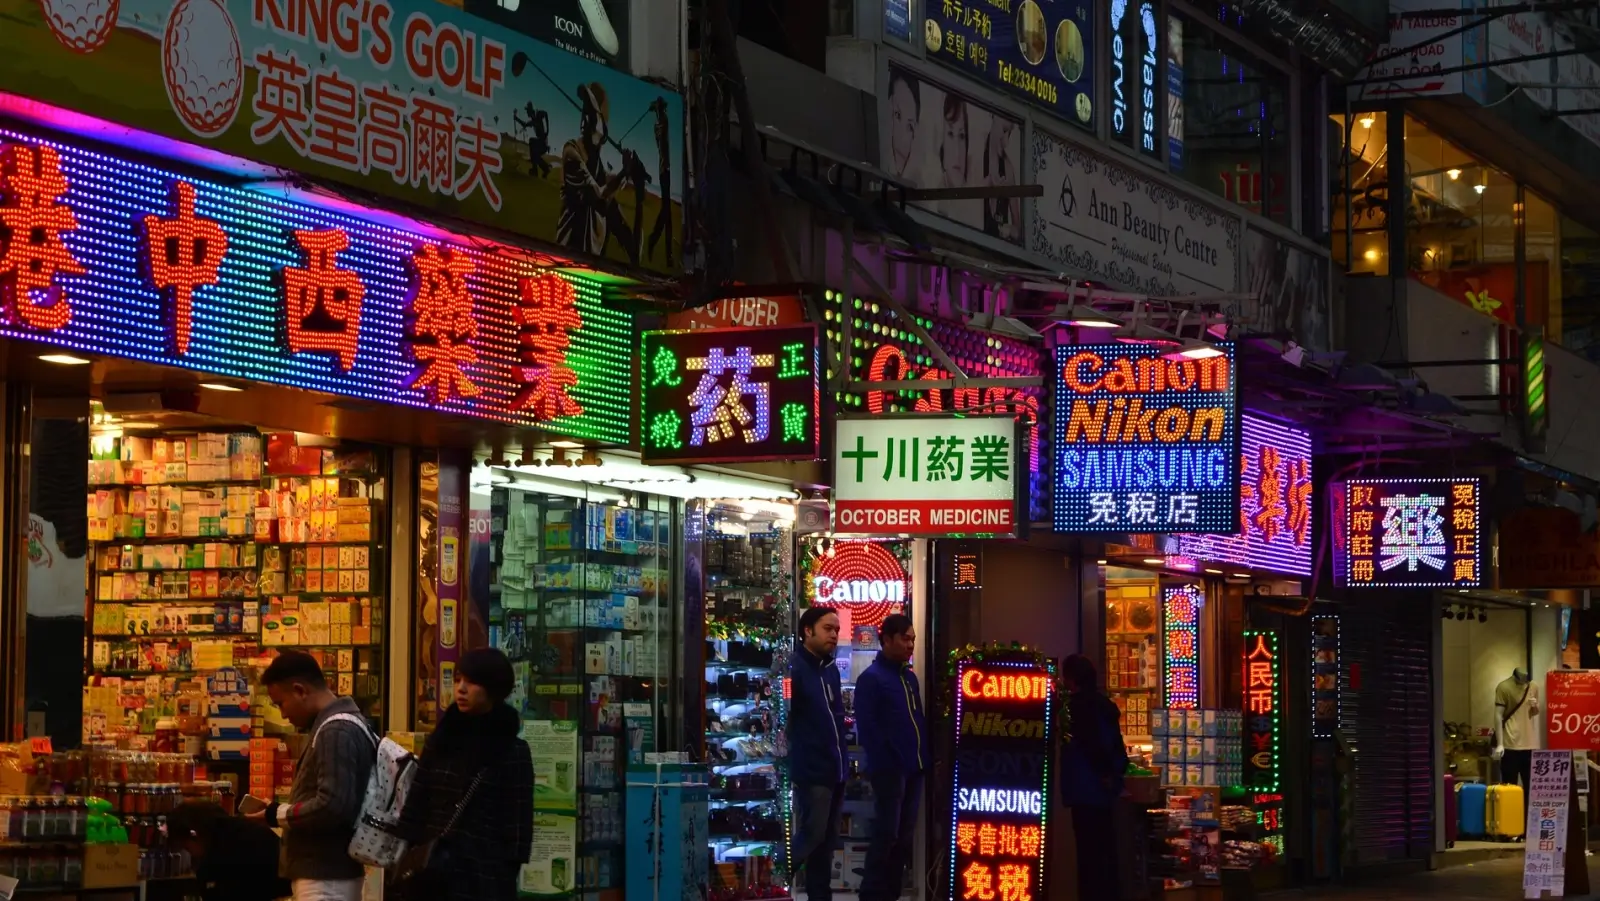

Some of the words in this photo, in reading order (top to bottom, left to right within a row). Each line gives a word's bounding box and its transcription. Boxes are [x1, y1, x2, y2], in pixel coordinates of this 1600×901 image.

[555, 16, 583, 38] ICON
[405, 16, 504, 98] GOLF
[254, 49, 501, 206] 英皇高爾夫
[1088, 188, 1118, 228] Ann
[1123, 201, 1170, 255] Beauty
[1174, 224, 1218, 267] Centre
[1063, 351, 1229, 394] Canon
[1064, 397, 1226, 443] Nikon
[1062, 449, 1225, 488] SAMSUNG
[840, 508, 921, 526] OCTOBER
[929, 508, 1010, 525] MEDICINE
[1379, 493, 1446, 572] 藥
[813, 576, 904, 603] Canon
[961, 669, 1049, 700] Canon
[960, 711, 1045, 738] Nikon
[1549, 712, 1600, 736] 50%
[958, 749, 1041, 777] SONY
[1532, 759, 1569, 777] 影印
[957, 787, 1042, 815] SAMSUNG
[956, 823, 1040, 857] 零售批發
[1538, 808, 1557, 852] 彩色影印
